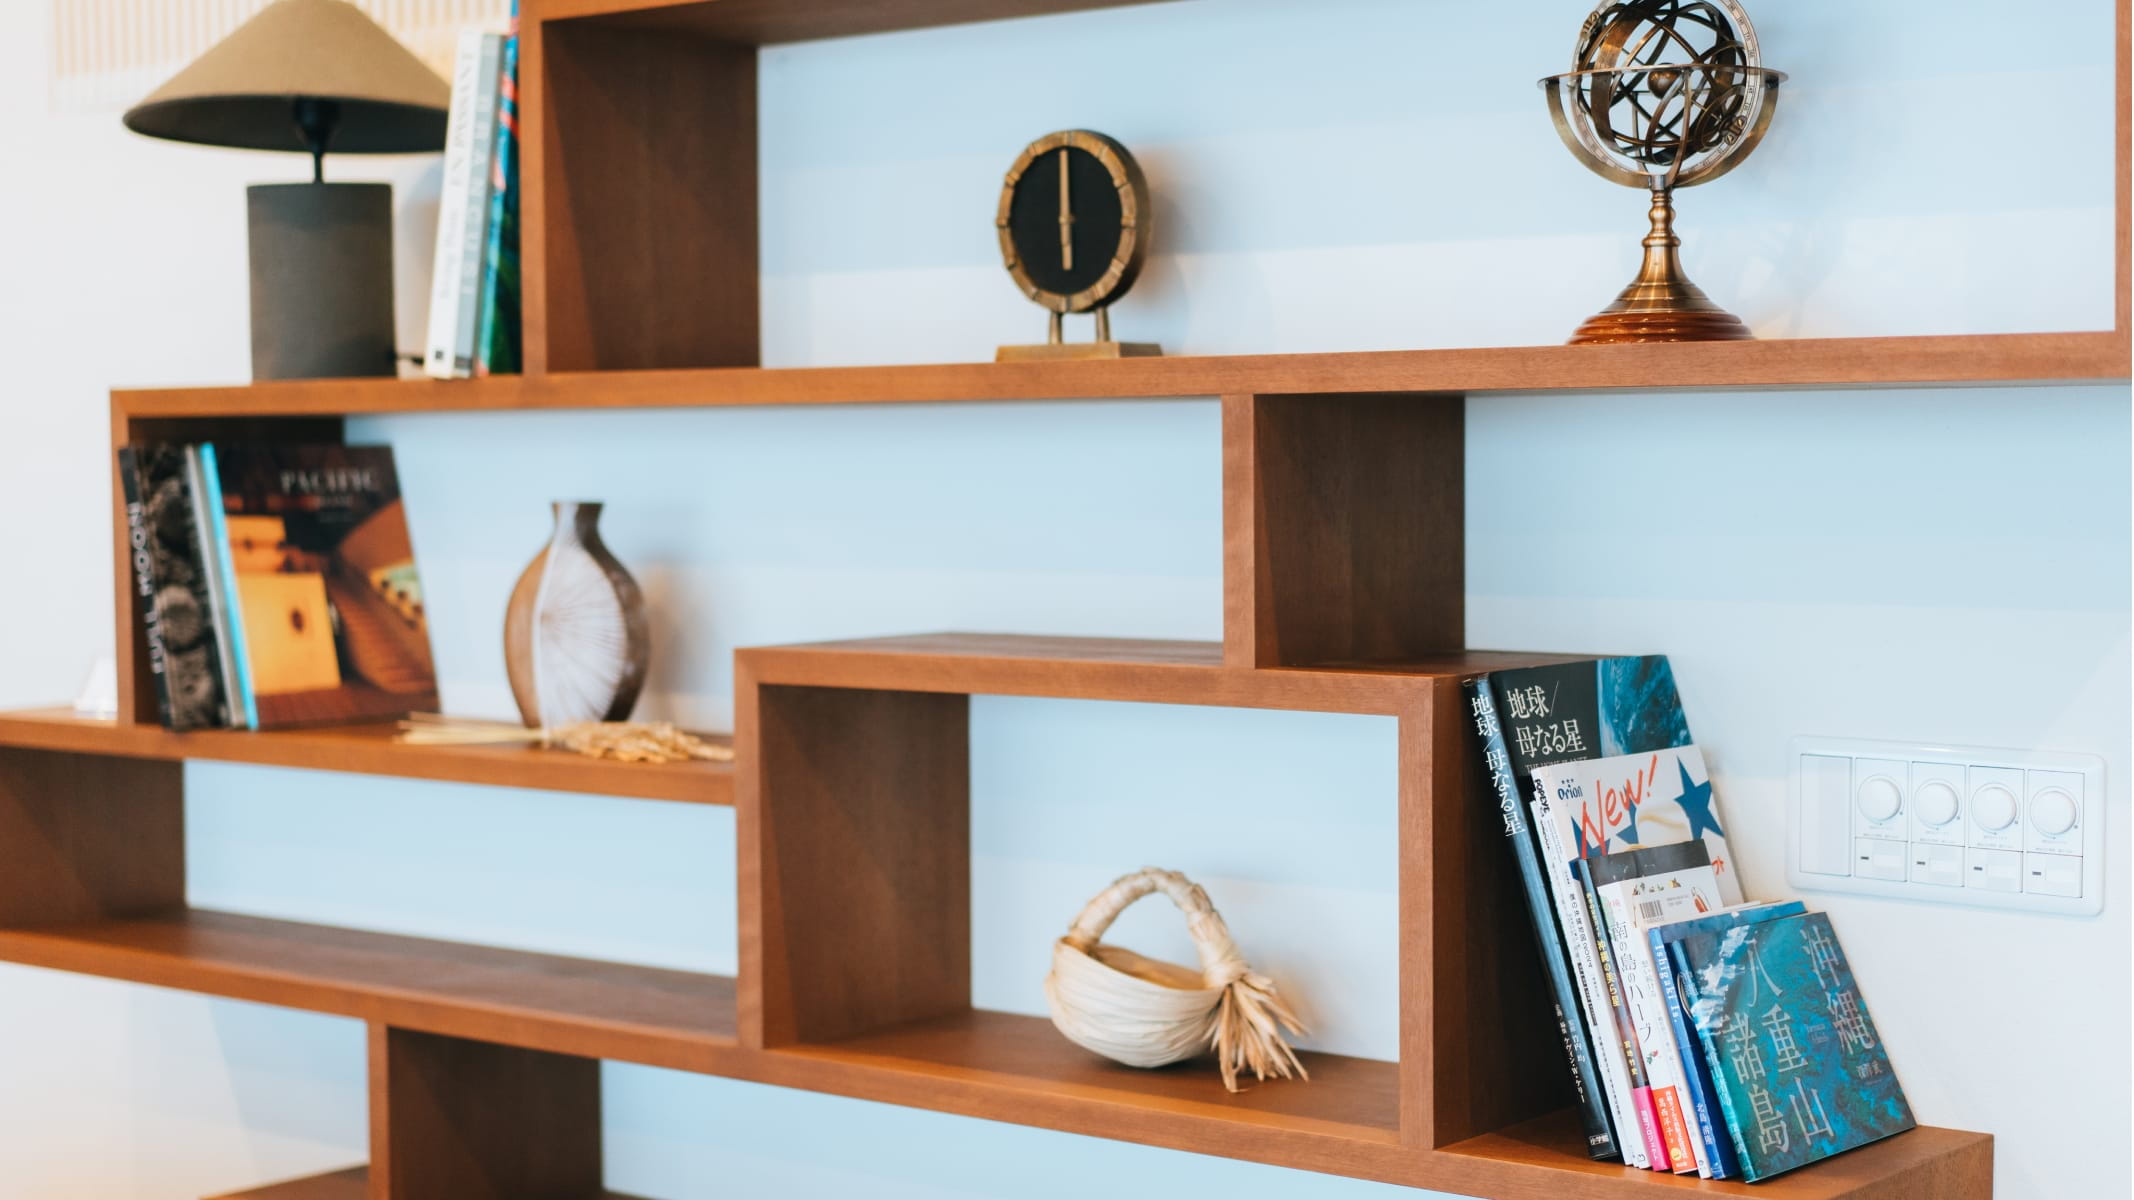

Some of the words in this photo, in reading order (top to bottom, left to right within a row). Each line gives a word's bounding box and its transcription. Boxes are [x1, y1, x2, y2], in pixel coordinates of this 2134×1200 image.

[127, 501, 152, 596] MOON
[1516, 719, 1587, 758] 母なる星
[1535, 779, 1550, 813] POPEYE
[1580, 754, 1658, 860] New!
[1613, 921, 1651, 1042] 南の島のハーブ
[1655, 945, 1676, 999] Ishigaki
[1799, 925, 1875, 1055] 沖縄
